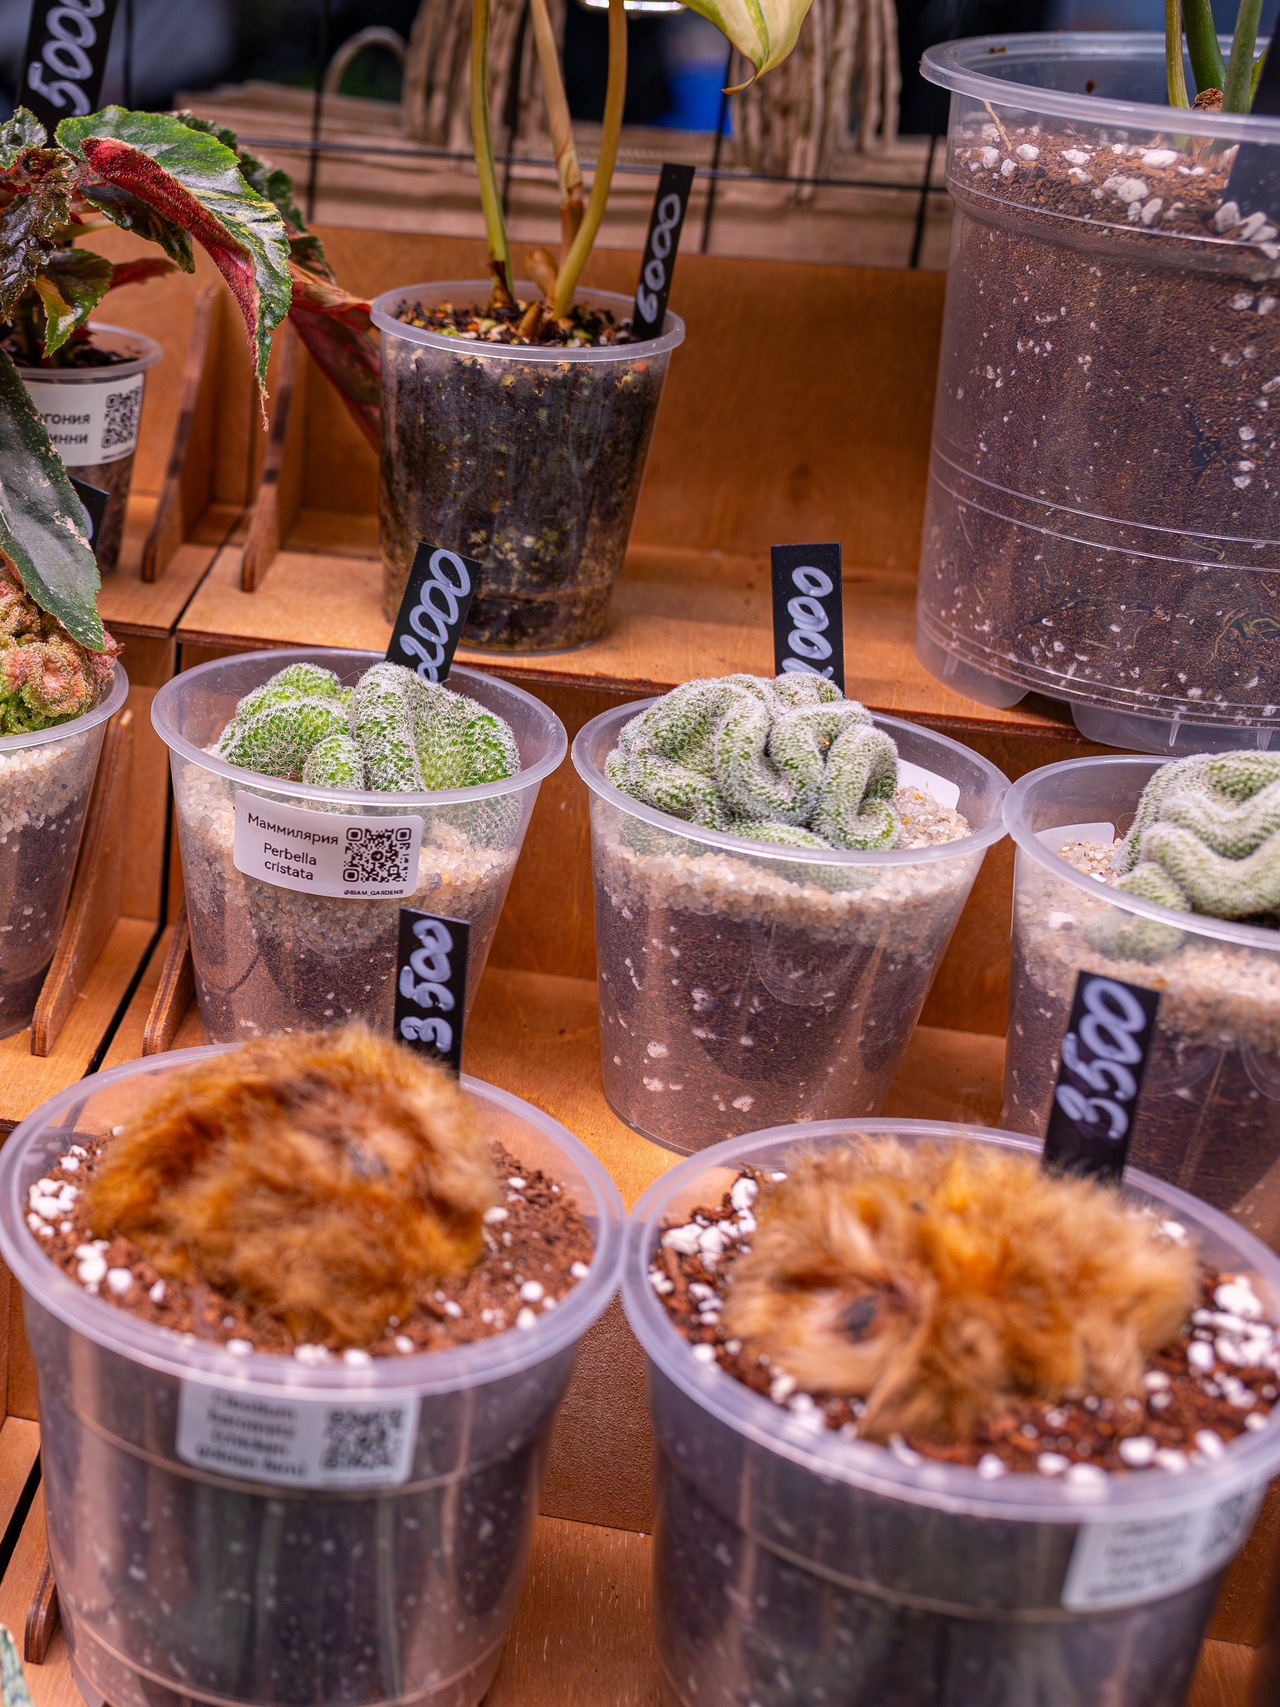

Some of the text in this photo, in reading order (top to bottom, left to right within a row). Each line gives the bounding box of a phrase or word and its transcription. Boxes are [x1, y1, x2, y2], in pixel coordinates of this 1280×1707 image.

[637, 193, 681, 324] 6000
[44, 413, 91, 425] гония
[49, 433, 88, 445] инни
[399, 548, 471, 683] 2000
[248, 812, 339, 846] Маммилярия
[263, 843, 317, 866] Perbella
[264, 860, 314, 881] cristata
[399, 918, 456, 1053] 3500
[1055, 978, 1147, 1140] 3500
